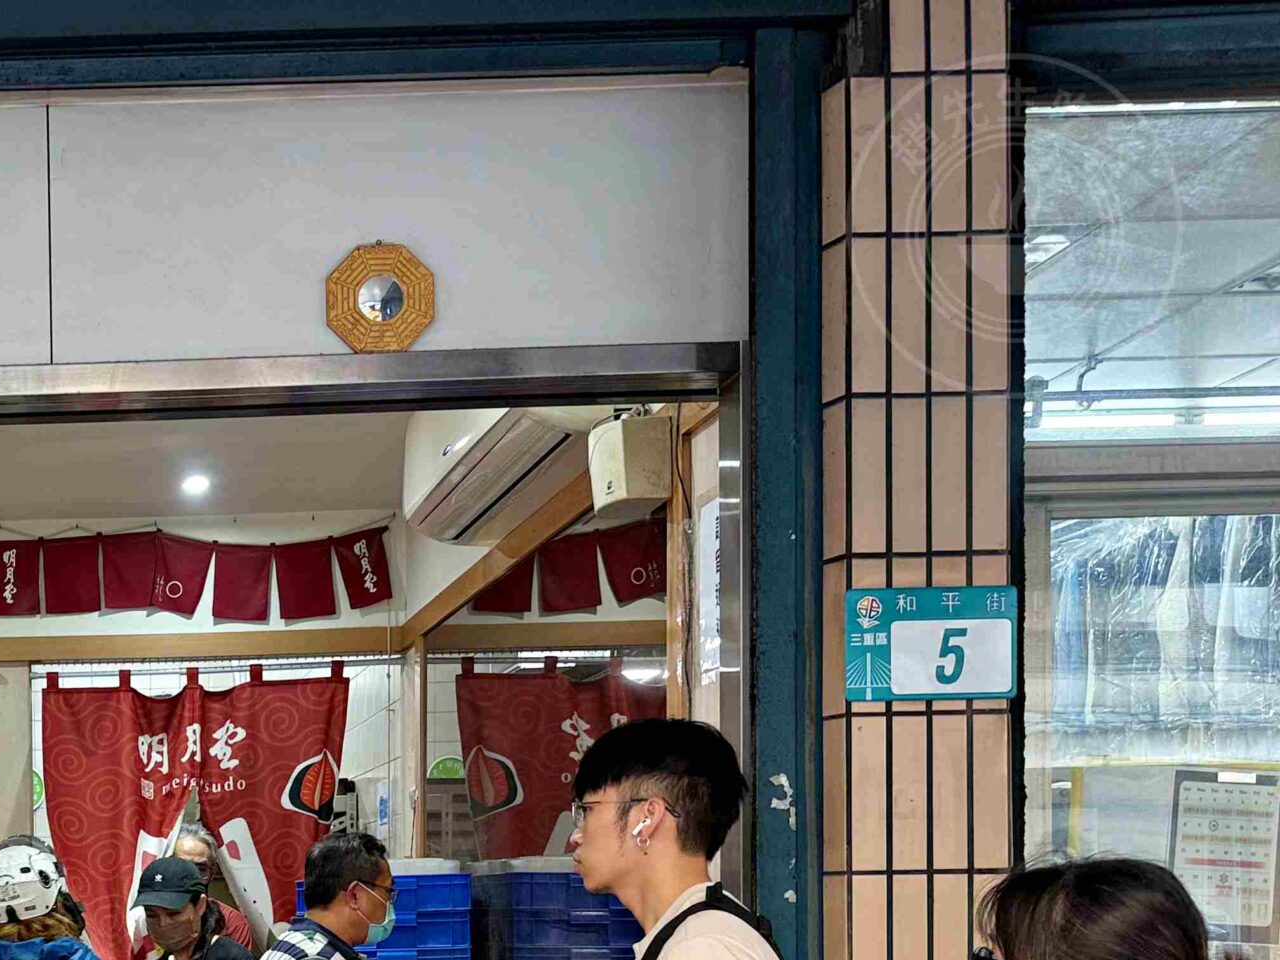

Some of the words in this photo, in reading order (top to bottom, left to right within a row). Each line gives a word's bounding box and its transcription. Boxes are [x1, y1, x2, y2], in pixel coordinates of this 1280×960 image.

[3, 549, 17, 604] 明月堂
[354, 539, 377, 593] 明月堂
[896, 592, 1006, 614] 和平街
[850, 632, 888, 646] 三重區
[935, 627, 968, 685] 5
[138, 719, 247, 775] 明月堂
